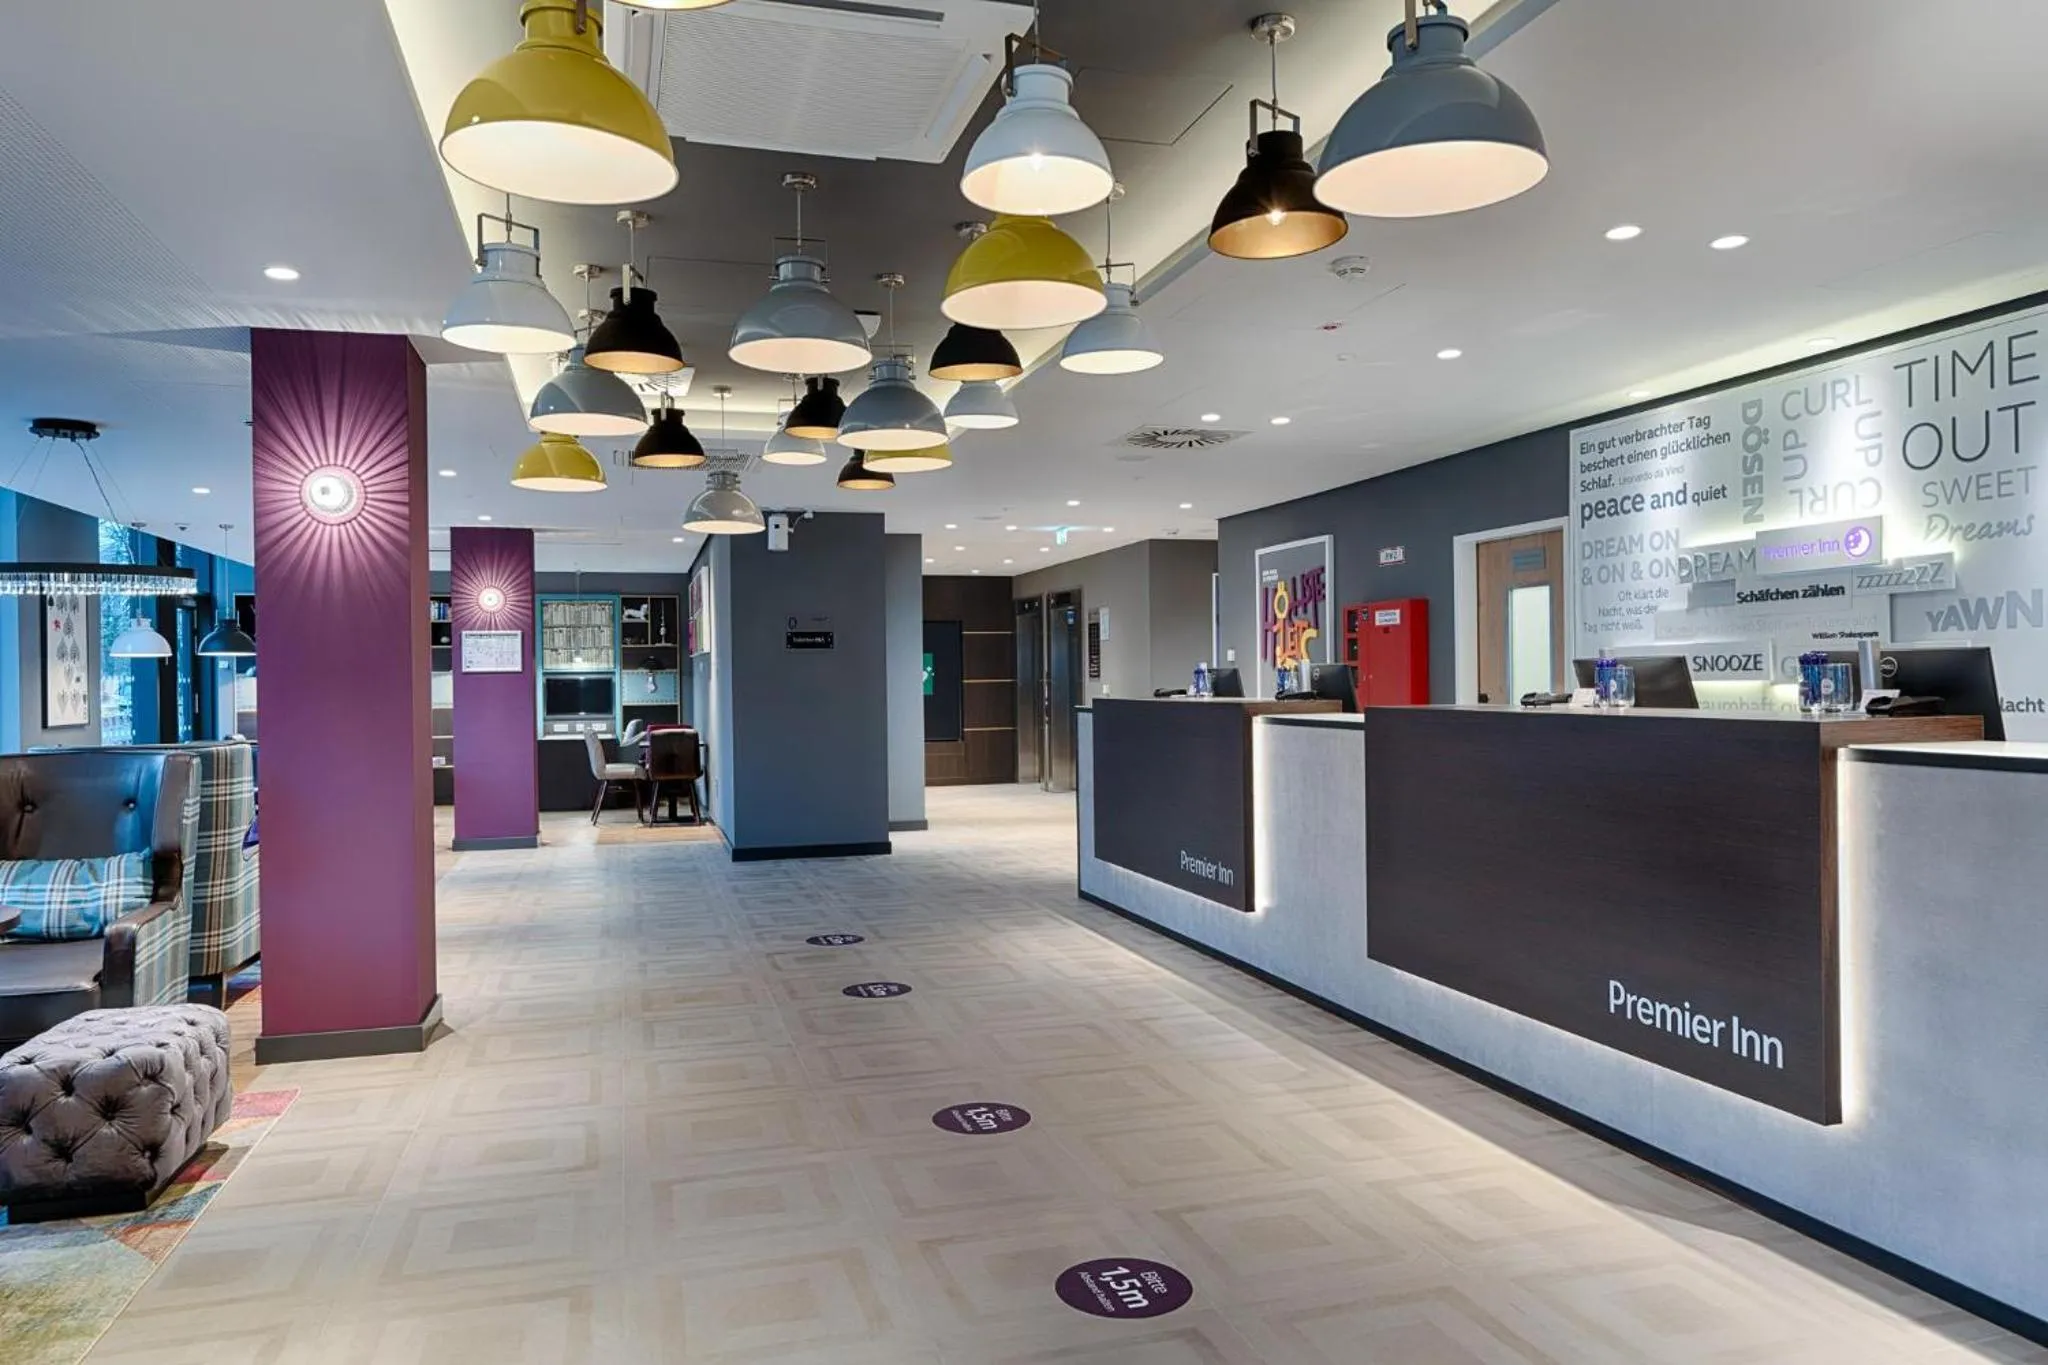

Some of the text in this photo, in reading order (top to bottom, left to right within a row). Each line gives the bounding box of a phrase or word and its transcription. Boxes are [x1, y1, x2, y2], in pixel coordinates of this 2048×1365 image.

[1893, 329, 2040, 408] TIME
[1781, 374, 1873, 421] CURL
[1580, 415, 1711, 455] Ein gut verbrachter Tag
[1580, 431, 1731, 474] beschert einen glücklichen
[1782, 428, 1808, 482] UP
[1855, 410, 1882, 468] UP
[1902, 400, 2036, 470] OUT
[1742, 398, 1770, 525] DÖSEN
[1580, 474, 1615, 492] Schlaf.
[1922, 465, 2037, 508] SWEET
[1581, 482, 1727, 529] peace and quiet
[1581, 528, 1680, 560] DREAM ON
[1923, 512, 2036, 542] Dreams
[1581, 567, 1593, 586] &
[1597, 562, 1625, 584] ON
[1630, 560, 1644, 581] &
[1678, 547, 1757, 584] DREAM
[1736, 583, 1845, 604] Schäfchen zählen
[1692, 653, 1764, 673] SNOOZE
[2000, 696, 2045, 714] acht
[1180, 849, 1234, 888] Premier Inn
[1609, 979, 1783, 1069] Premier Inn
[964, 1106, 998, 1130] 1,5m
[1099, 1266, 1149, 1309] 1,5m
[1140, 1270, 1168, 1294] Bitte
